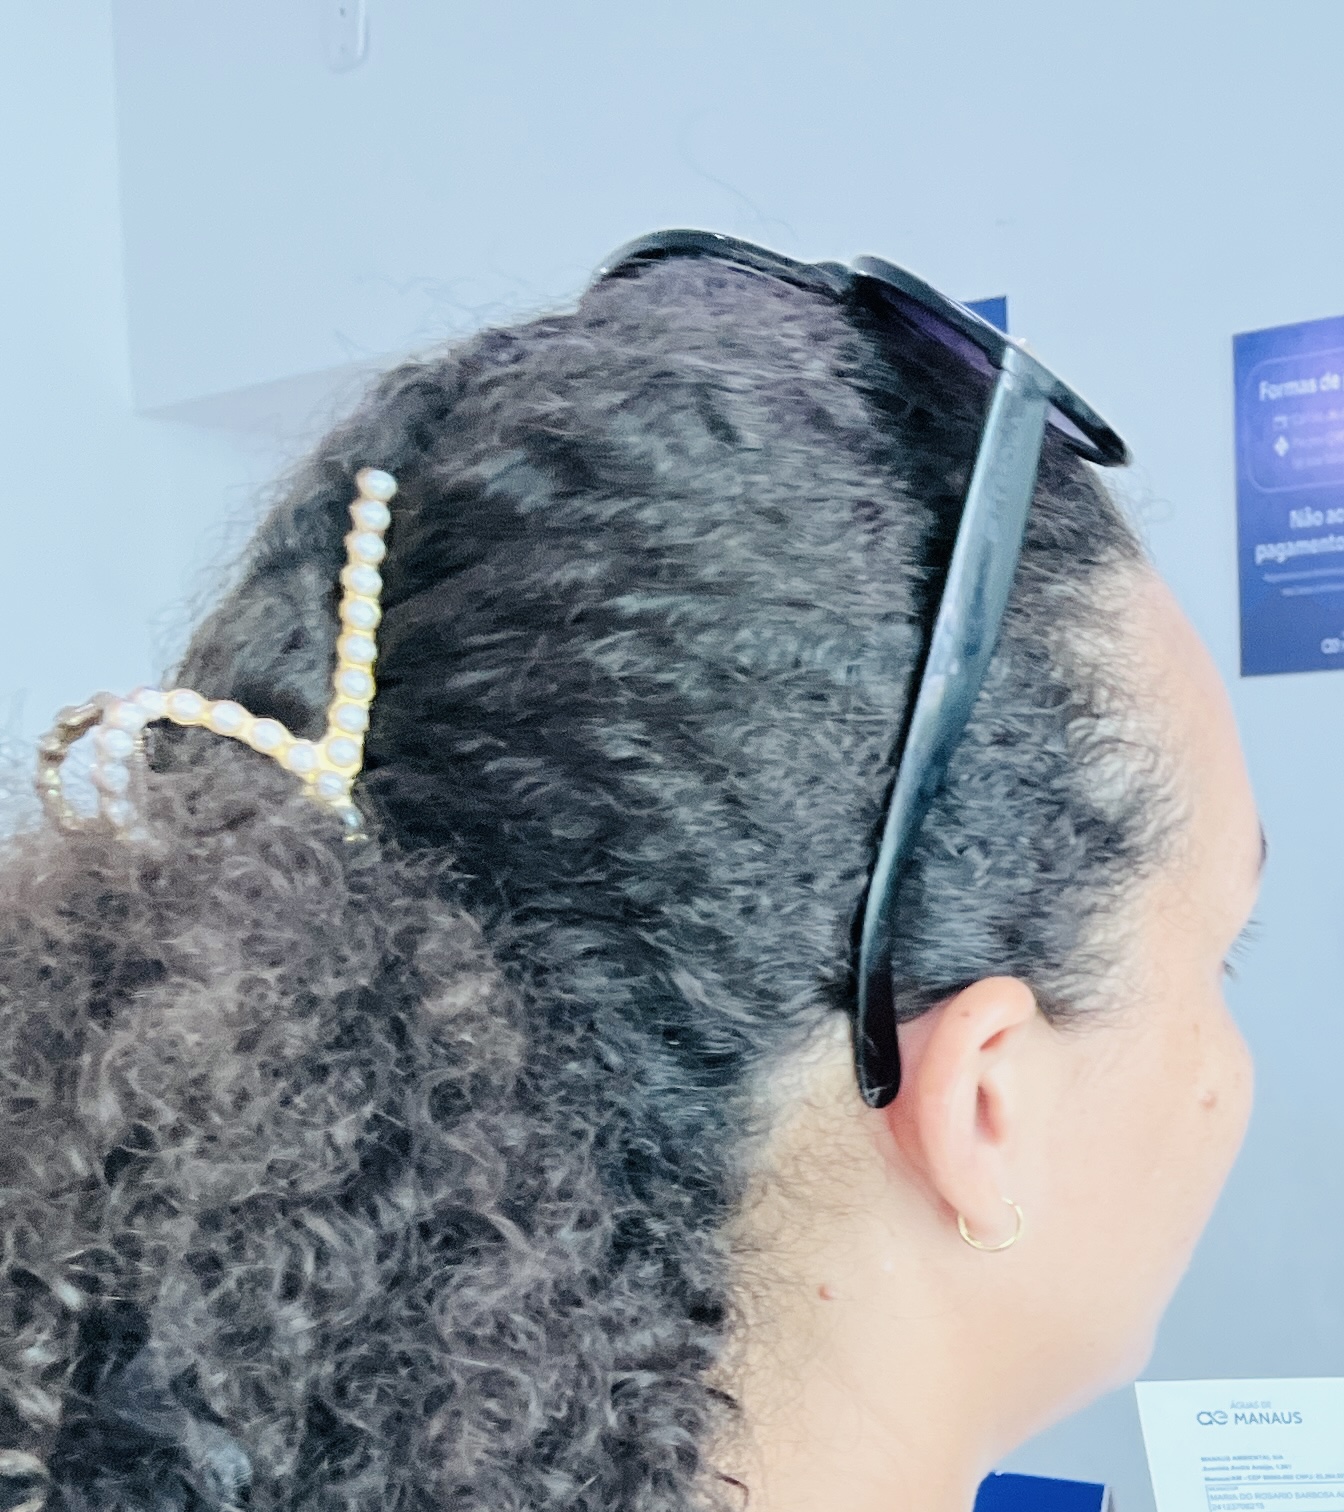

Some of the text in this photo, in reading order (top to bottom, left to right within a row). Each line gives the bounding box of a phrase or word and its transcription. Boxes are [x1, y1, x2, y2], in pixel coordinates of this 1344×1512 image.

[1259, 379, 1318, 401] Formas
[1319, 372, 1341, 393] de
[1289, 506, 1324, 529] Não
[1234, 1411, 1303, 1425] MANAUS
[1295, 1491, 1334, 1499] BARBOSA
